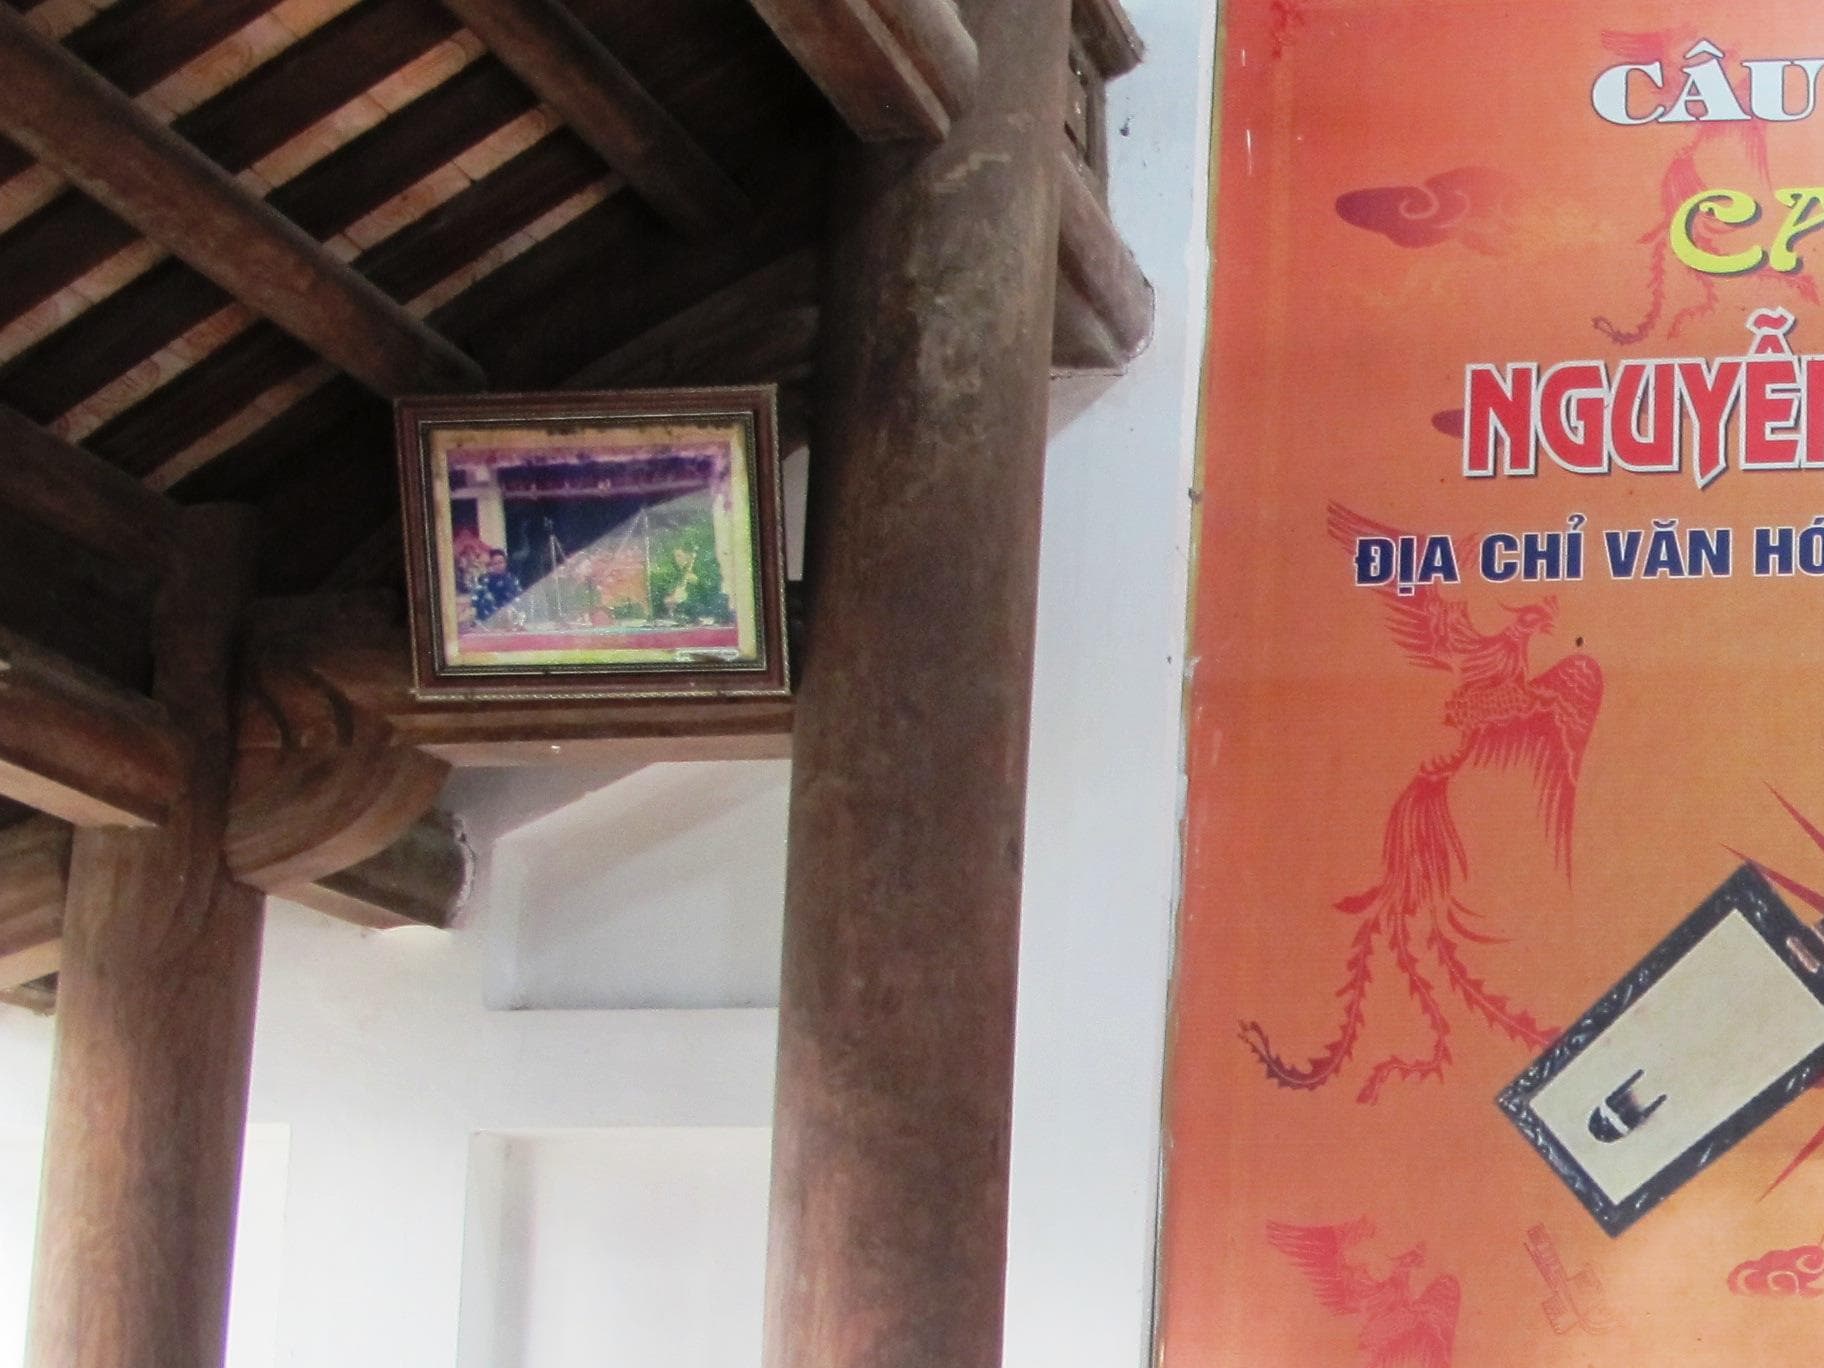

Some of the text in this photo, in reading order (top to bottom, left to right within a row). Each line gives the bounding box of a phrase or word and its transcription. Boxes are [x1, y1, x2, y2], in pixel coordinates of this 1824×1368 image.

[1354, 534, 1461, 596] ĐỊA
[1480, 512, 1586, 583] CHỈ
[1604, 518, 1732, 579] VĂN
